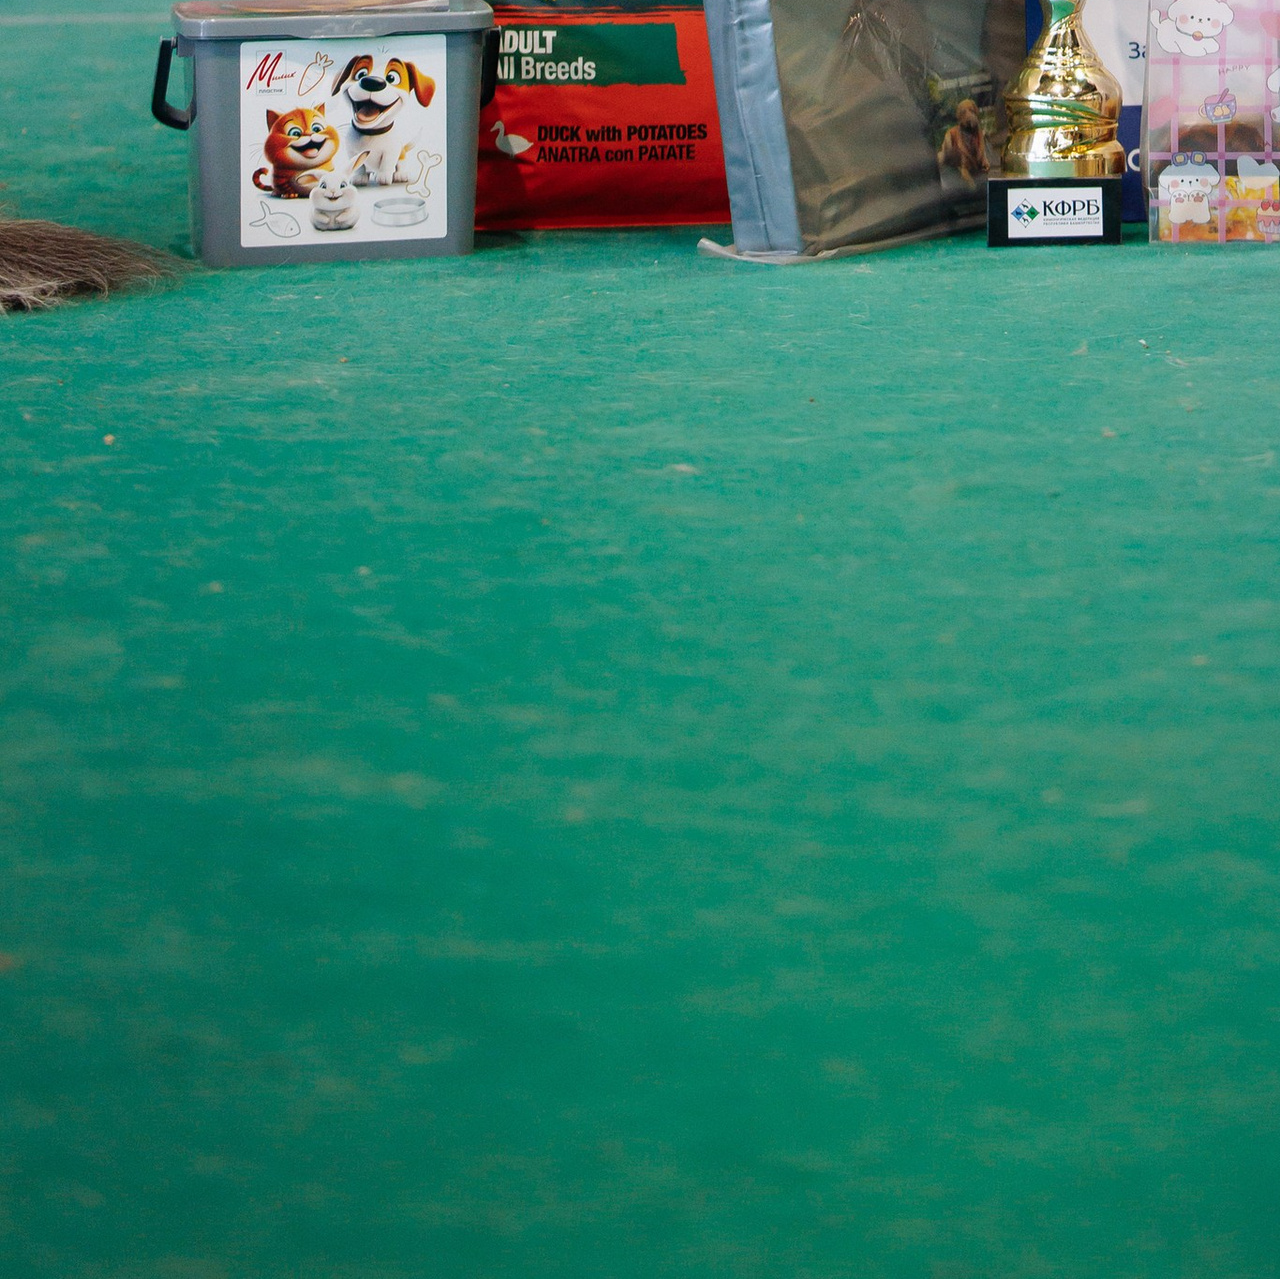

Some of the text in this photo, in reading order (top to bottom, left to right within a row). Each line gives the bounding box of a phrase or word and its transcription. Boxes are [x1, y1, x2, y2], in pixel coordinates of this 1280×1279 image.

[499, 30, 557, 54] DULT
[521, 56, 597, 81] Breeds
[1218, 64, 1251, 76] HAPPY
[537, 124, 708, 142] DUCK with POTATOES
[536, 144, 696, 163] ANATRA con PATATE
[1042, 199, 1100, 216] КФРБ
